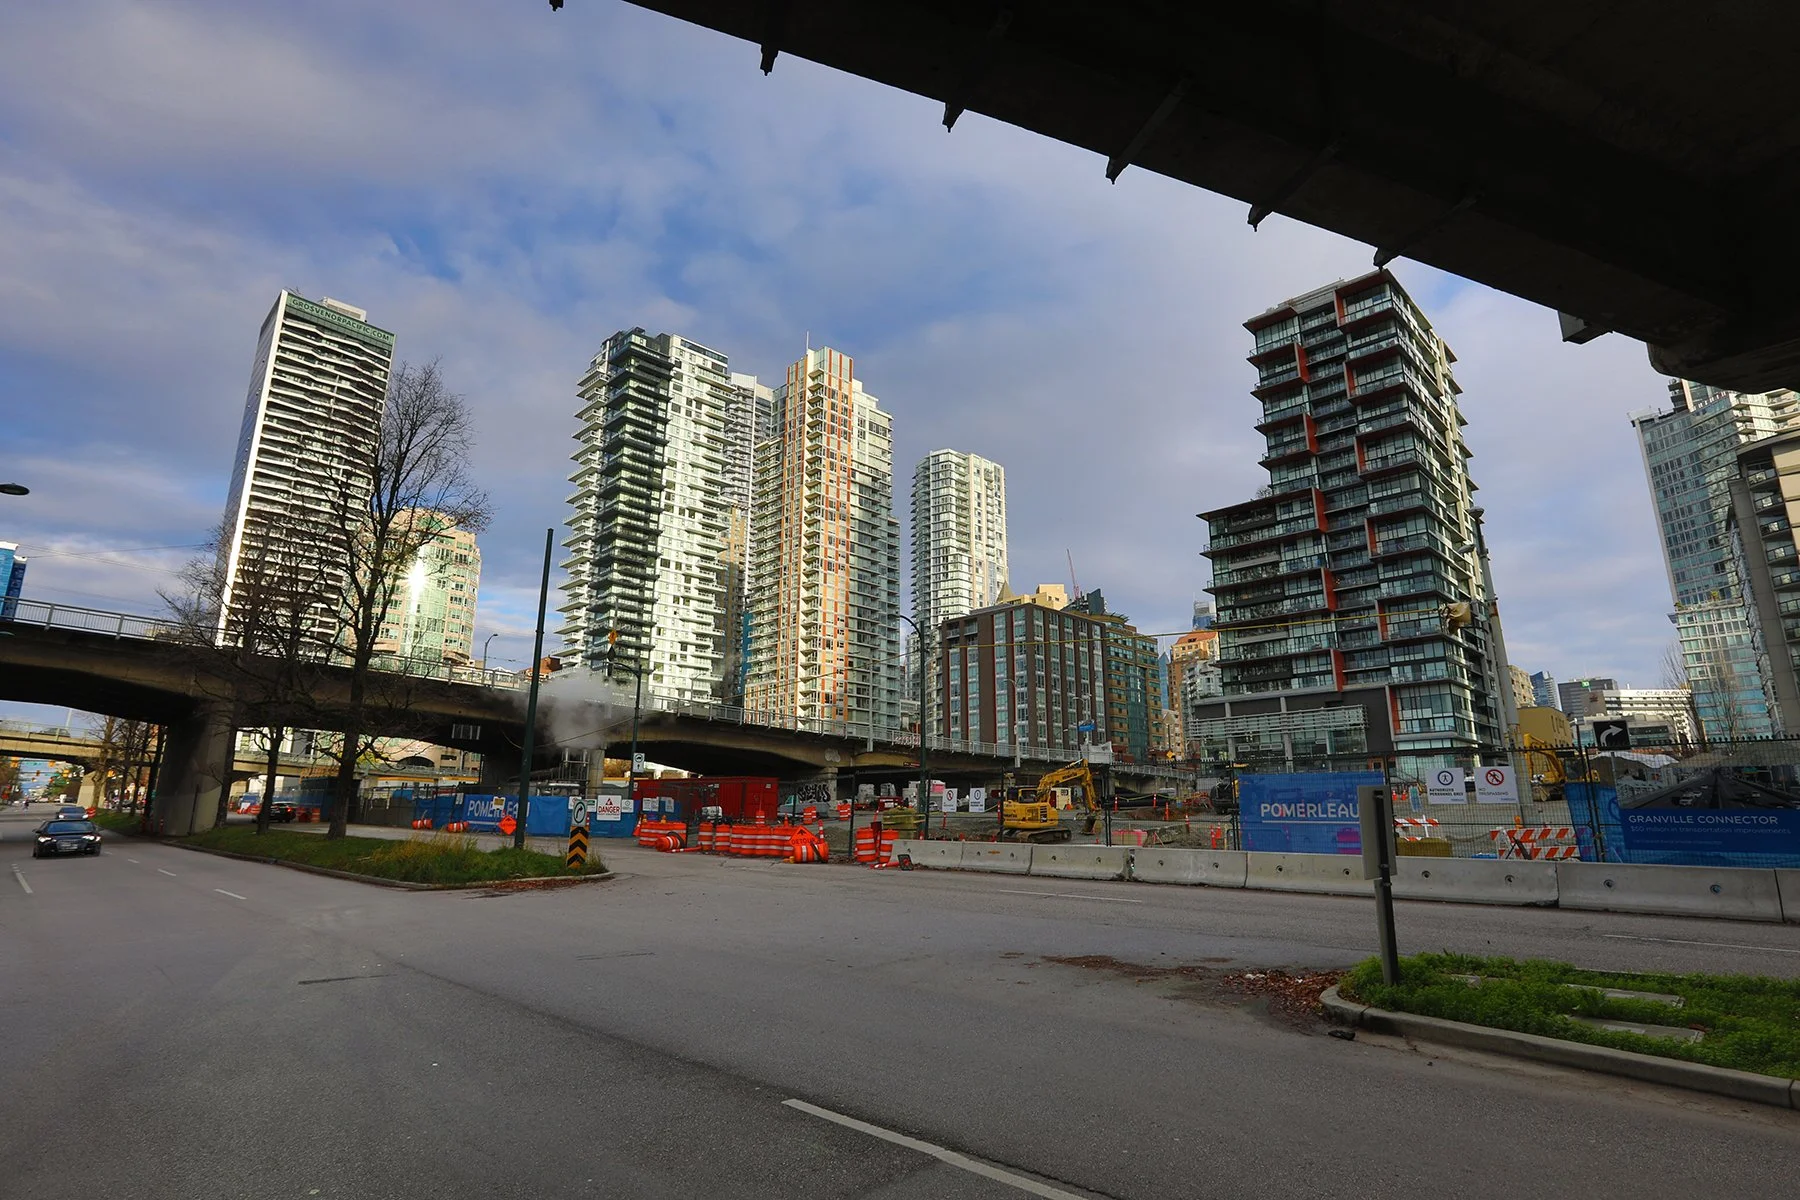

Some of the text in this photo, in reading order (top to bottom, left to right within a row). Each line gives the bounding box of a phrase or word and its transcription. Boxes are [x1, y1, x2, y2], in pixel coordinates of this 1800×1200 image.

[1260, 803, 1360, 818] POMERLEAU
[1628, 815, 1778, 824] GRANVILLE CONNECTOR
